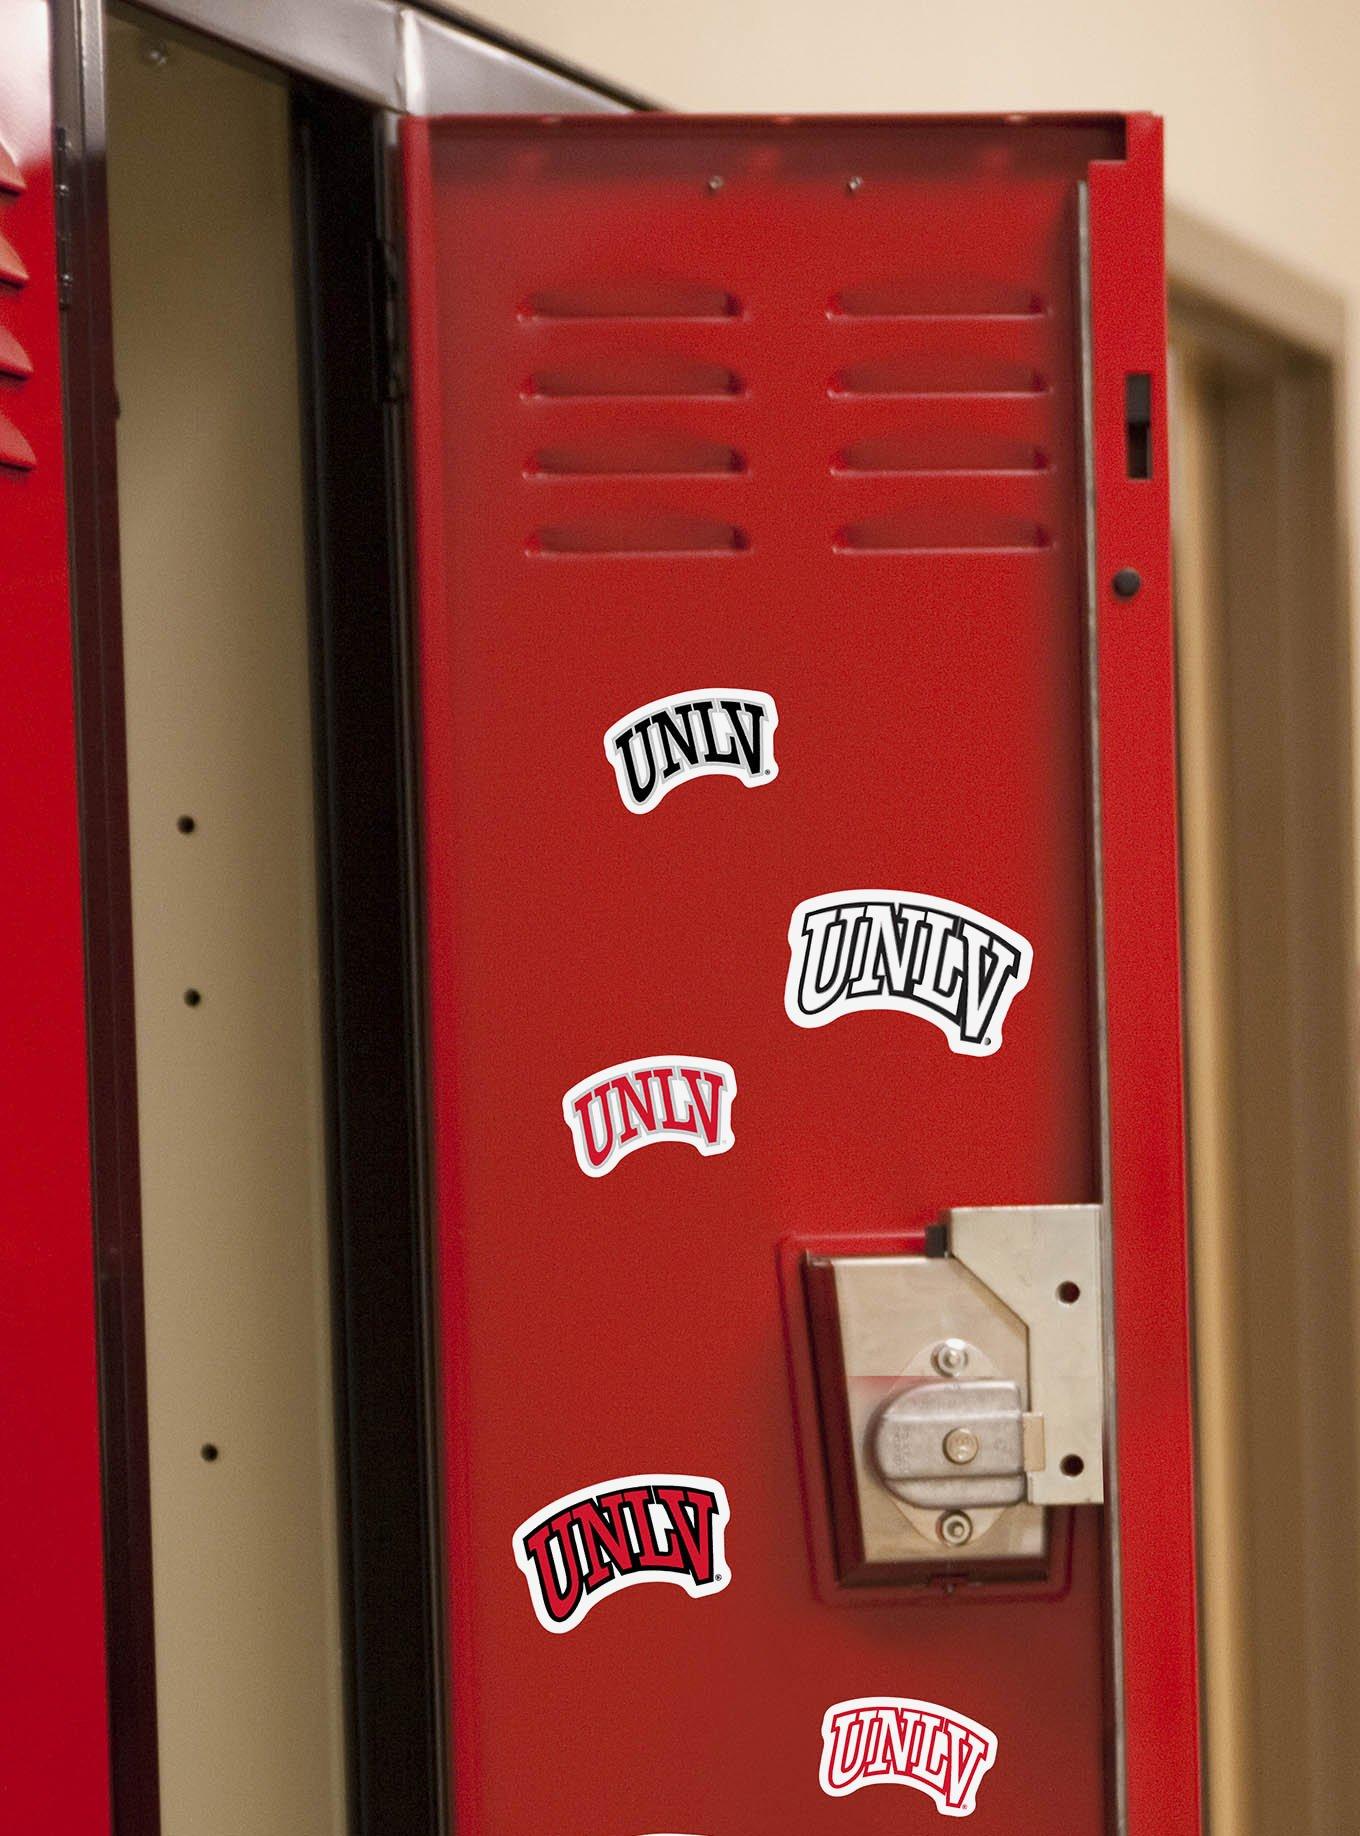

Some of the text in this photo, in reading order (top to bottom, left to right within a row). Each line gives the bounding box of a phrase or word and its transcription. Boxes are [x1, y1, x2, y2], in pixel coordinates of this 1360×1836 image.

[612, 698, 769, 805] UNLV
[798, 902, 1021, 1044] UNLV
[572, 1066, 727, 1169] UNLV
[523, 1485, 719, 1622] UNLV
[828, 1706, 989, 1808] UNLV
